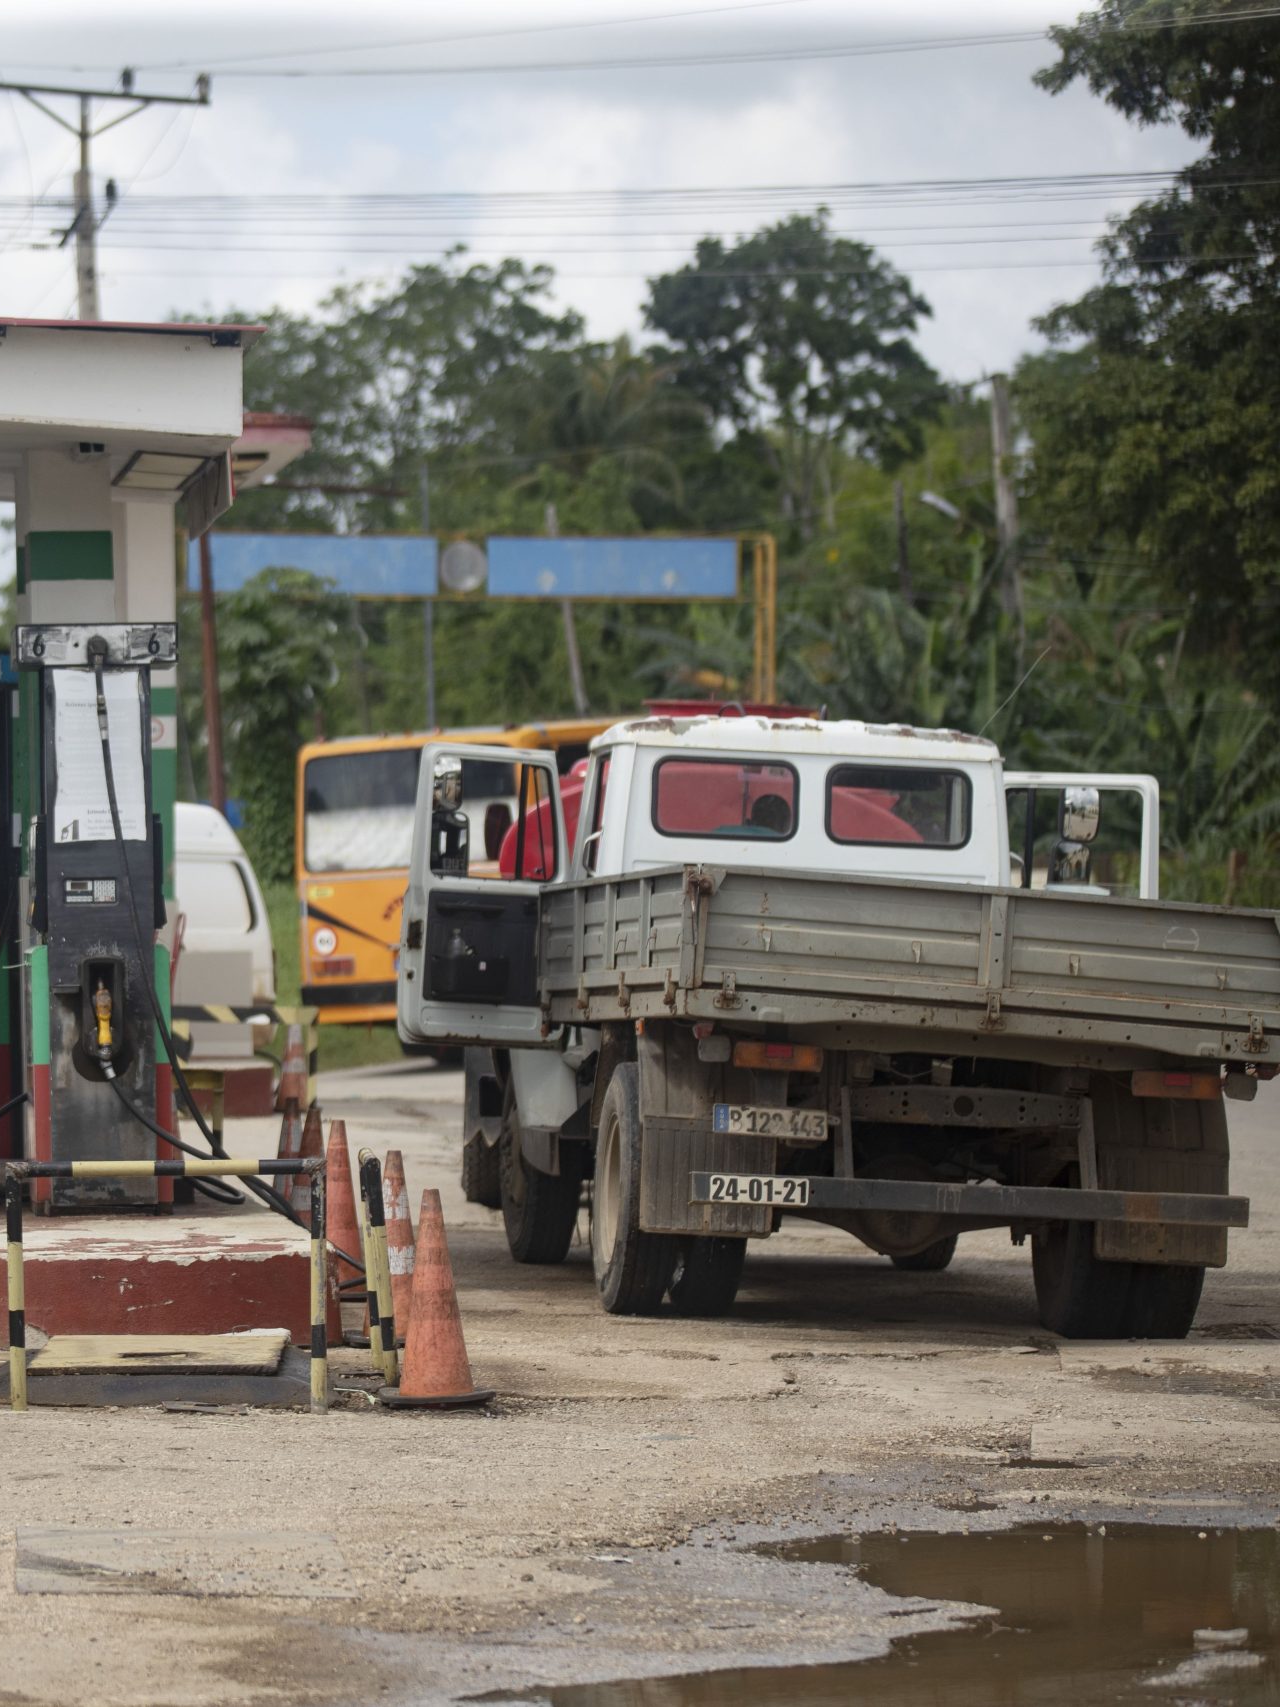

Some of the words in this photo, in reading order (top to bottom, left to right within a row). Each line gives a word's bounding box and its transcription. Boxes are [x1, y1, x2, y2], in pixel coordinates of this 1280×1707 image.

[33, 634, 45, 657] 6
[148, 632, 160, 654] 6
[712, 1177, 807, 1203] 24-01-21
